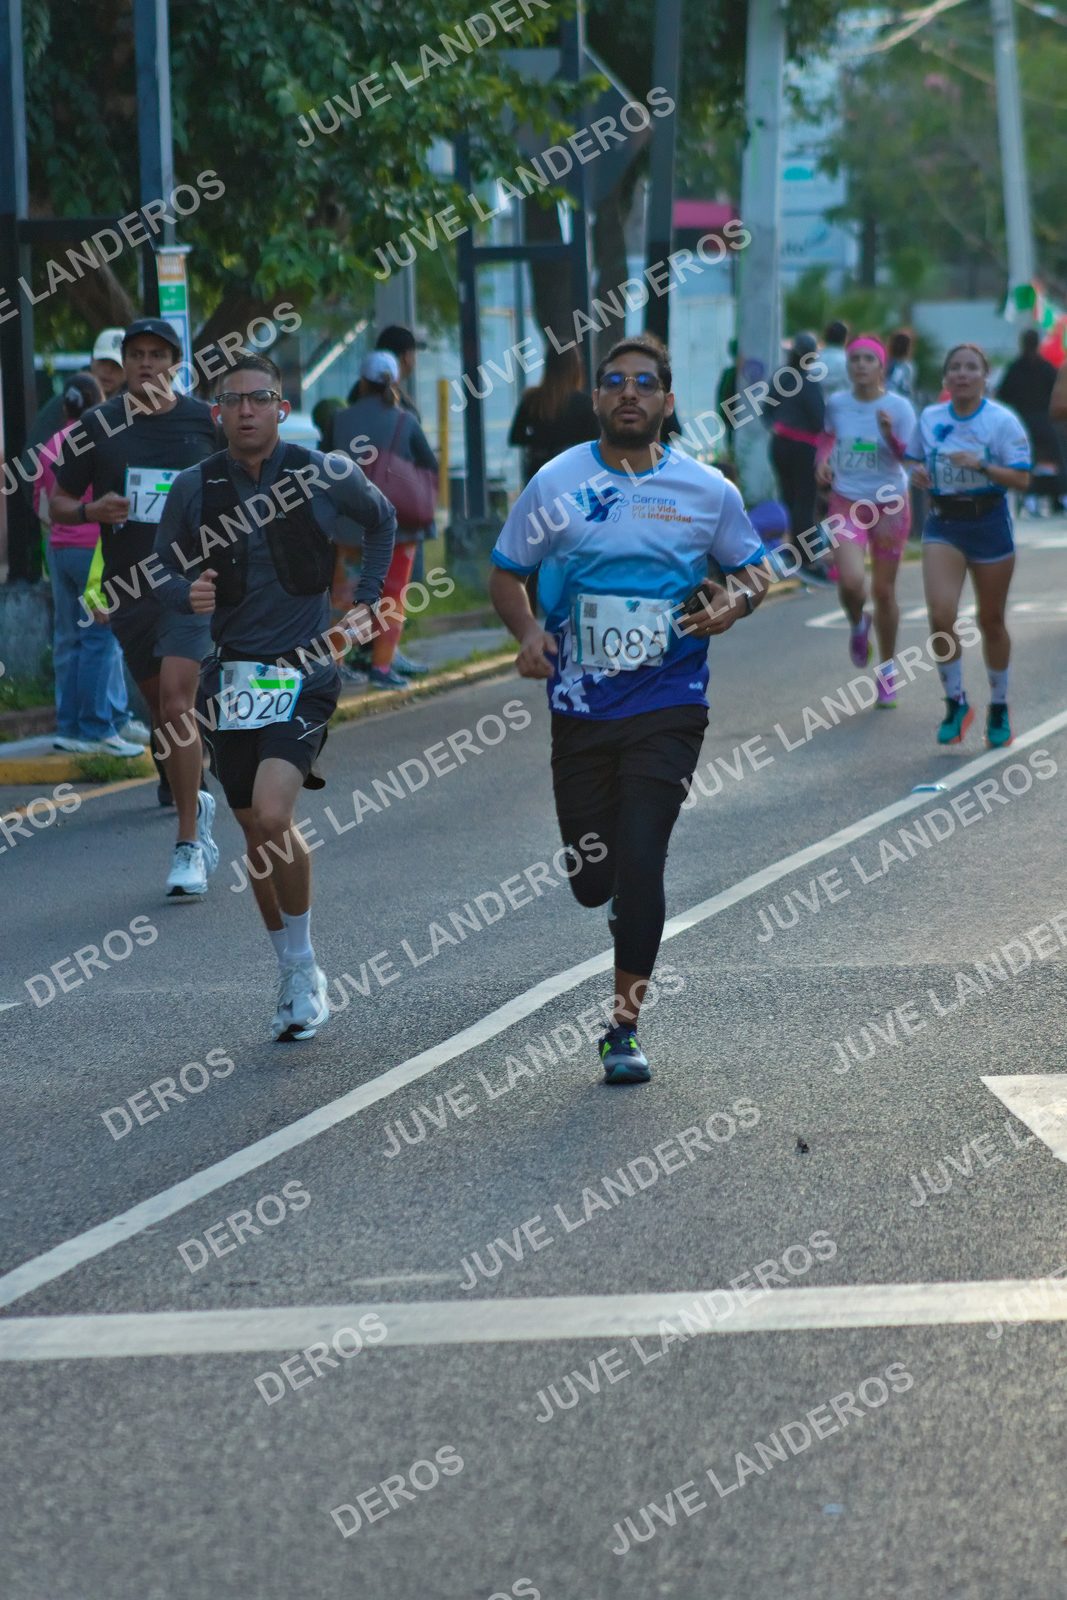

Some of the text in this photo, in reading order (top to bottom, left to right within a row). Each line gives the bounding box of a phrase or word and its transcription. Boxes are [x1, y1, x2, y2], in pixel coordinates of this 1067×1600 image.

[131, 491, 168, 514] 17
[632, 494, 676, 506] Carrera
[658, 504, 677, 513] Vida
[647, 512, 692, 523] Integridad
[227, 691, 293, 720] 1020
